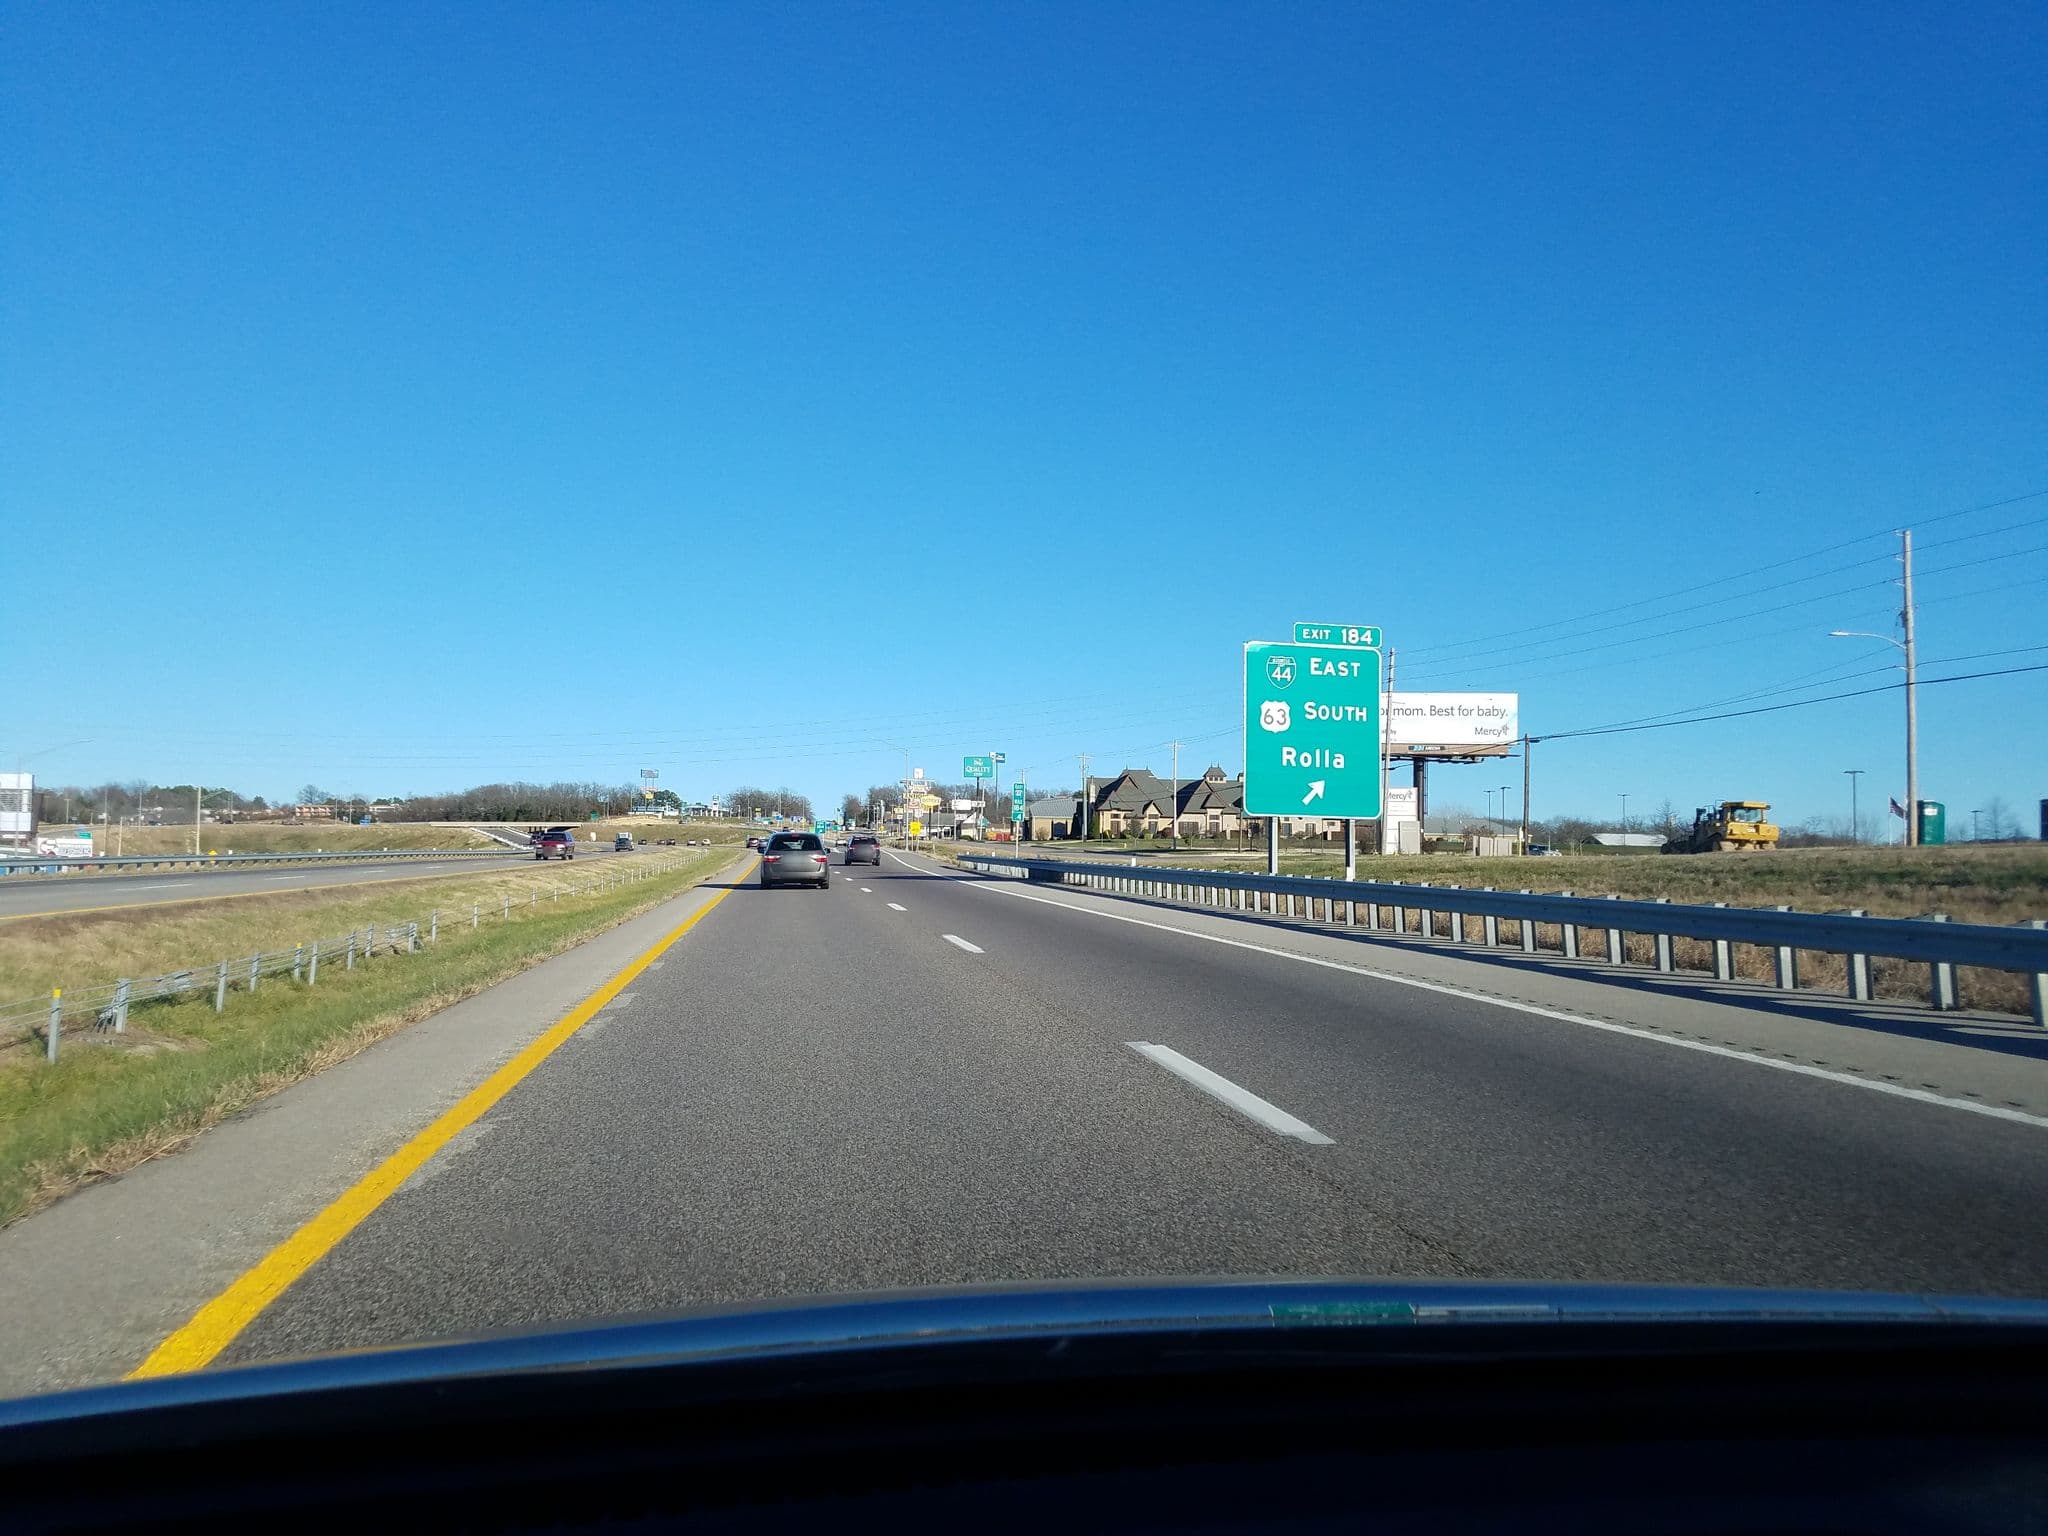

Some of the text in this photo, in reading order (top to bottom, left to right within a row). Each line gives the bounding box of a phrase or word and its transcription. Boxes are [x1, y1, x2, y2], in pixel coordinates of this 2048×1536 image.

[1302, 628, 1373, 645] EXIT 184
[1271, 666, 1292, 682] 44
[1310, 657, 1361, 678] EAST
[1263, 701, 1367, 726] 63 SOUTH
[1393, 707, 1427, 717] mom.
[1429, 705, 1455, 717] Best
[1457, 704, 1474, 717] for
[1477, 705, 1508, 720] baby.
[1474, 726, 1502, 737] Mercy
[1282, 746, 1345, 769] Rolla
